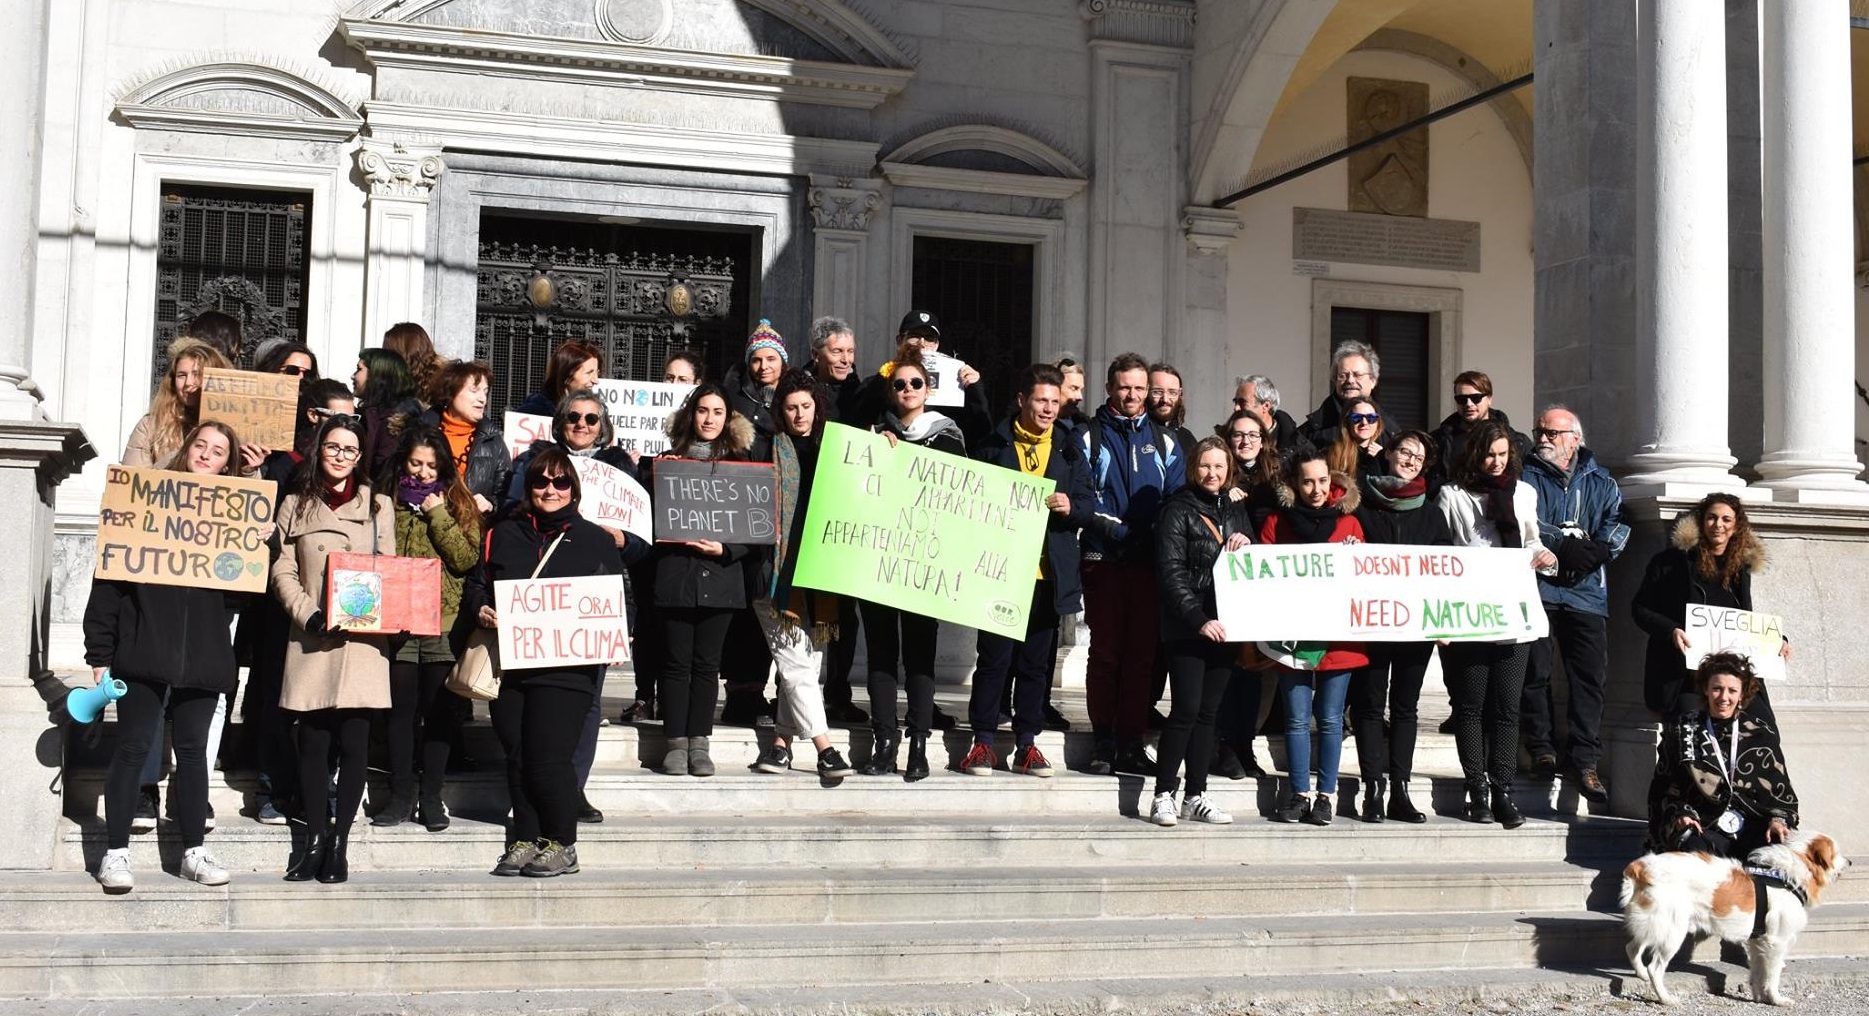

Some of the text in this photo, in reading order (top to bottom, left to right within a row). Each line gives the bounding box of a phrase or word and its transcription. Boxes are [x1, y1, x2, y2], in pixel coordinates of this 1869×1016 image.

[652, 391, 674, 408] LIN
[640, 416, 658, 431] PAR
[580, 459, 617, 481] SAVE
[580, 473, 599, 486] THE
[843, 440, 1045, 513] LA NATURA NON
[866, 473, 882, 497] CI
[108, 468, 271, 523] IO MANIFESTO
[603, 481, 646, 515] CLIMATE
[663, 476, 770, 504] THERE'S NO
[101, 508, 136, 528] PER
[165, 516, 260, 551] NOSTRO
[668, 507, 775, 538] PLANET B
[822, 520, 941, 560] APPARTENIAMO
[1419, 554, 1464, 577] NEED
[510, 583, 571, 614] AGITE
[1350, 598, 1410, 628] NEED
[1422, 598, 1508, 631] NATURE
[1691, 606, 1782, 639] SVEGLIA
[512, 625, 629, 660] PER IL CLIMA
